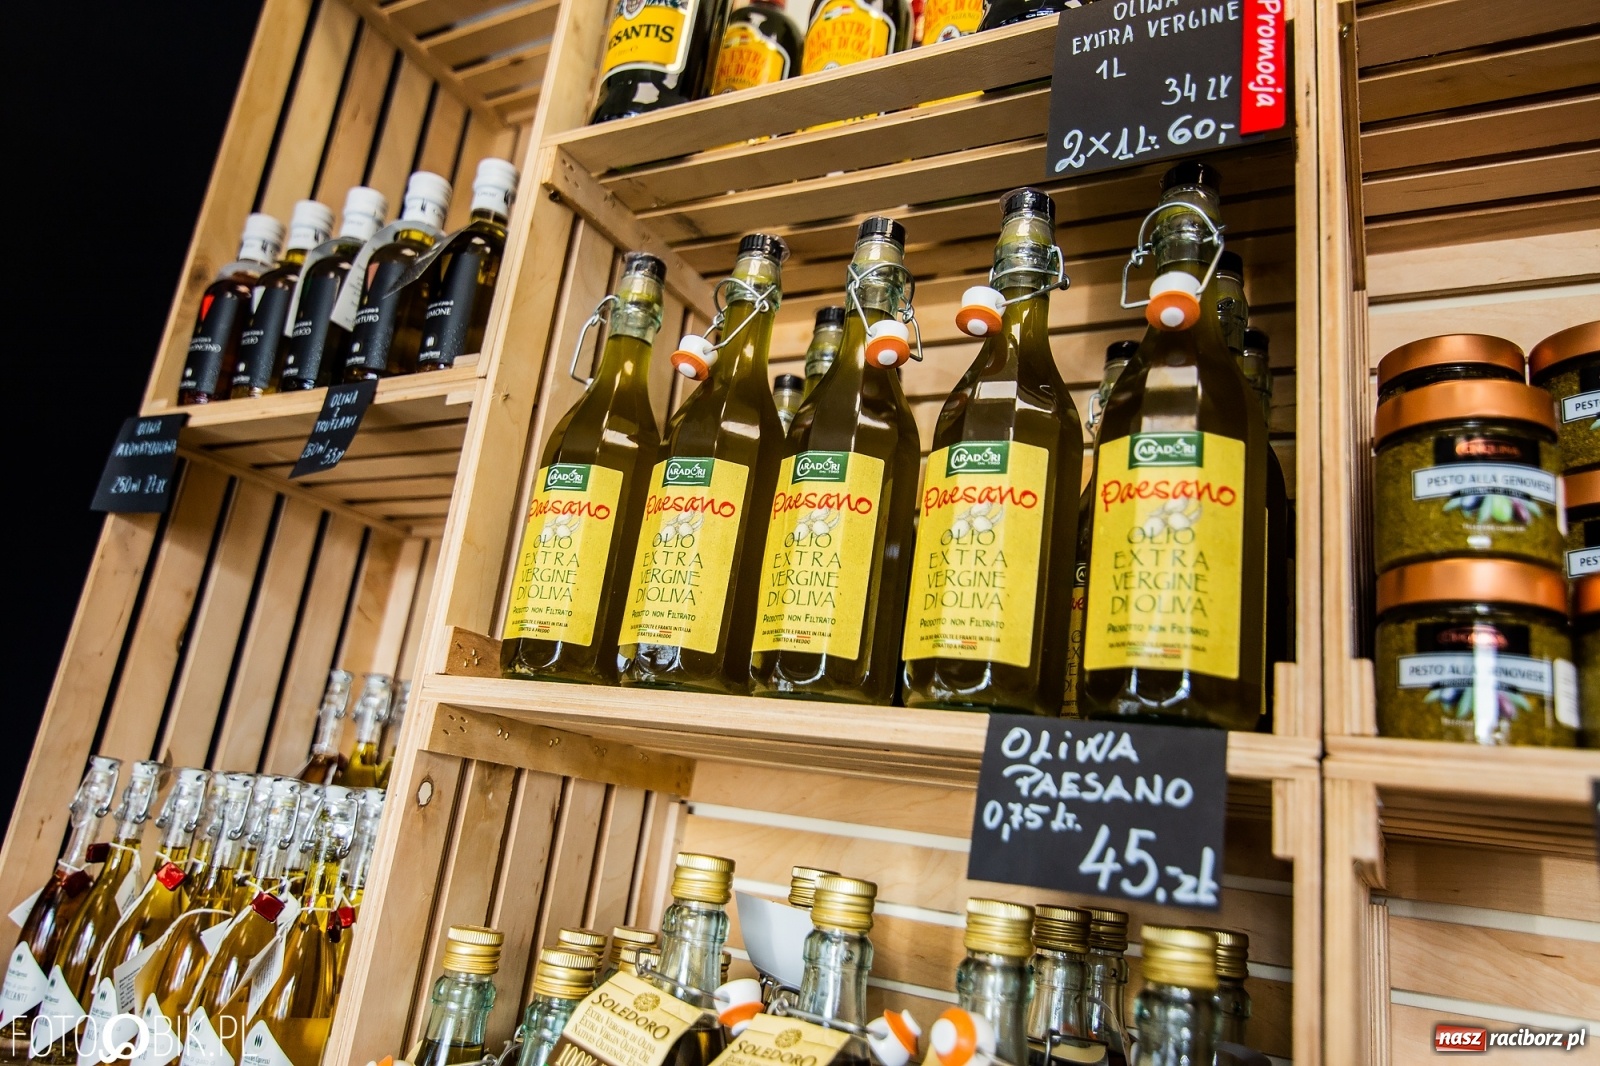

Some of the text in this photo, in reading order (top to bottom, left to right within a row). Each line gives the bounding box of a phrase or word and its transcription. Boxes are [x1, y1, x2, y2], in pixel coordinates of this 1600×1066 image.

[1147, 0, 1239, 38] VERGINE
[1248, 0, 1284, 107] Promocja
[1095, 57, 1126, 80] 1L
[1161, 73, 1197, 106] 34
[951, 447, 1001, 469] CARADORI
[1133, 438, 1197, 461] CARADORI
[666, 462, 706, 480] CARADORI
[797, 457, 840, 477] CARADORI
[1427, 474, 1552, 491] PESTO ALLA GENOVESE
[533, 534, 573, 549] OLIO
[652, 532, 695, 548] OLIO
[784, 531, 832, 548] OLIO
[940, 528, 996, 546] OLIO
[1127, 526, 1196, 545] OLIO
[524, 551, 579, 567] EXTRA
[643, 550, 703, 569] EXTRA
[773, 550, 842, 569] EXTRA
[929, 549, 1008, 569] EXTRA
[1113, 548, 1210, 571] EXTRA
[521, 567, 577, 584] VERGINE
[641, 568, 701, 587] VERGINE
[771, 569, 839, 588] VERGINE
[928, 569, 1006, 590] VERGINE
[1112, 570, 1208, 594] VERGINE
[528, 584, 572, 602] OLIVA
[646, 586, 696, 606] OLIVA
[782, 588, 836, 608] OLIVA
[941, 590, 1004, 611] OLIVA
[1135, 594, 1208, 618] OLIVA
[804, 613, 836, 625] FILTRATO
[969, 617, 1005, 629] FILTRATO
[1409, 664, 1445, 676] PESTO
[1002, 763, 1194, 809] PAESANO
[983, 799, 1051, 842] 0,75
[579, 1015, 599, 1033] EXTRA
[591, 992, 670, 1040] SOLEDORO
[606, 1016, 630, 1038] VERGINE
[731, 1040, 817, 1066] SOLEDORO
